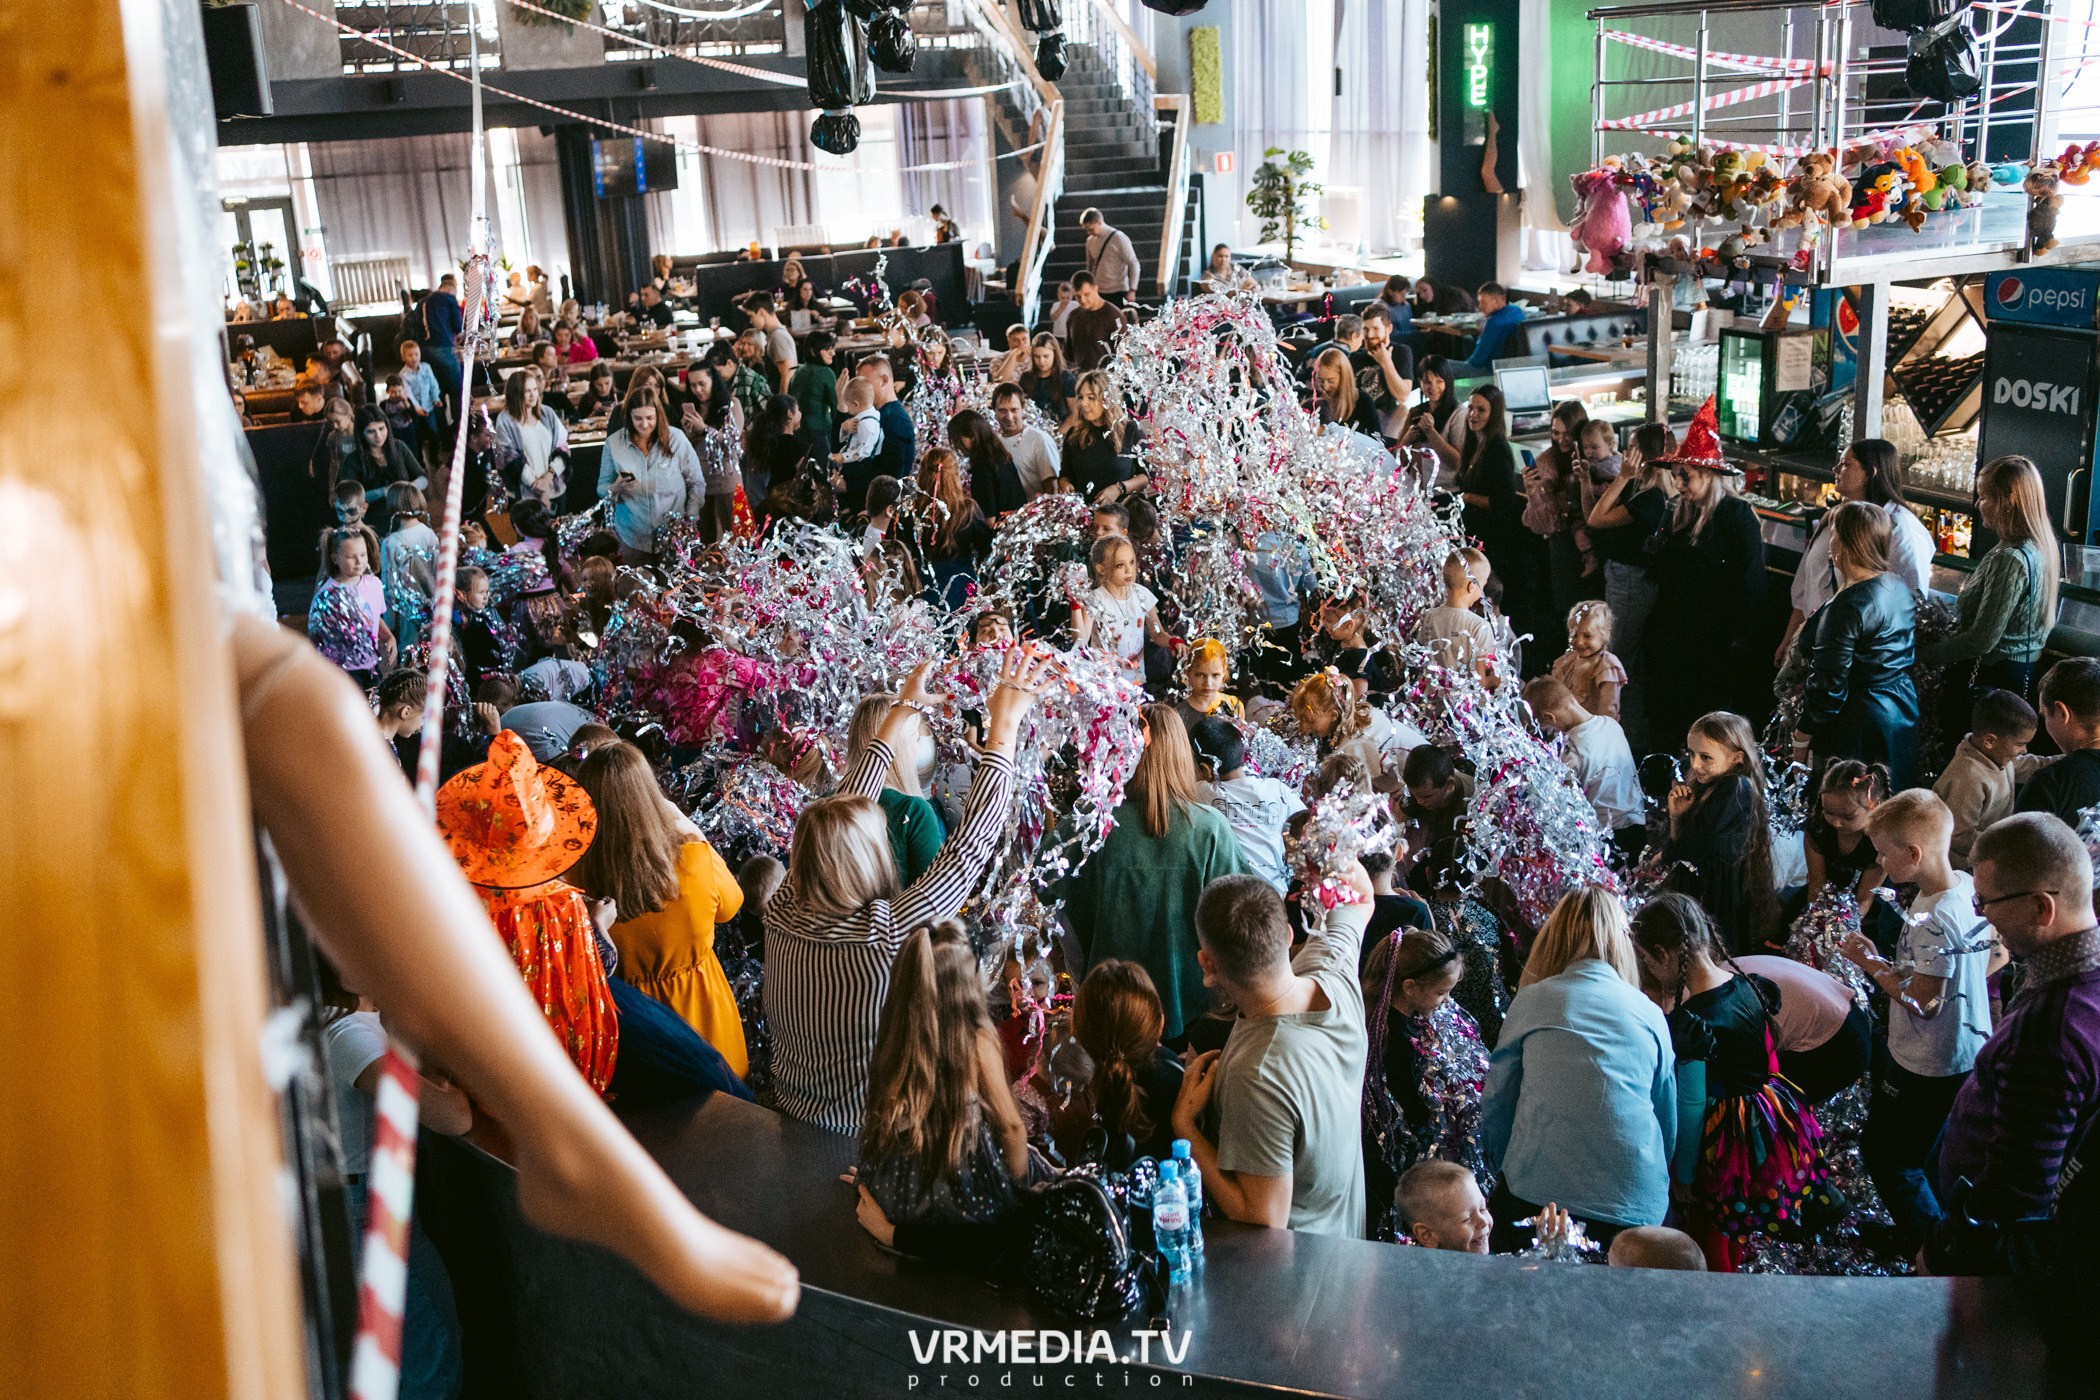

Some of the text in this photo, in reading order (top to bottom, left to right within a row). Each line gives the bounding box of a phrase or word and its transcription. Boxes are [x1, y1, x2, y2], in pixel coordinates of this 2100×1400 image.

[1470, 24, 1489, 106] HYPE
[2029, 288, 2086, 310] pepsi
[1994, 376, 2080, 415] DOSKI
